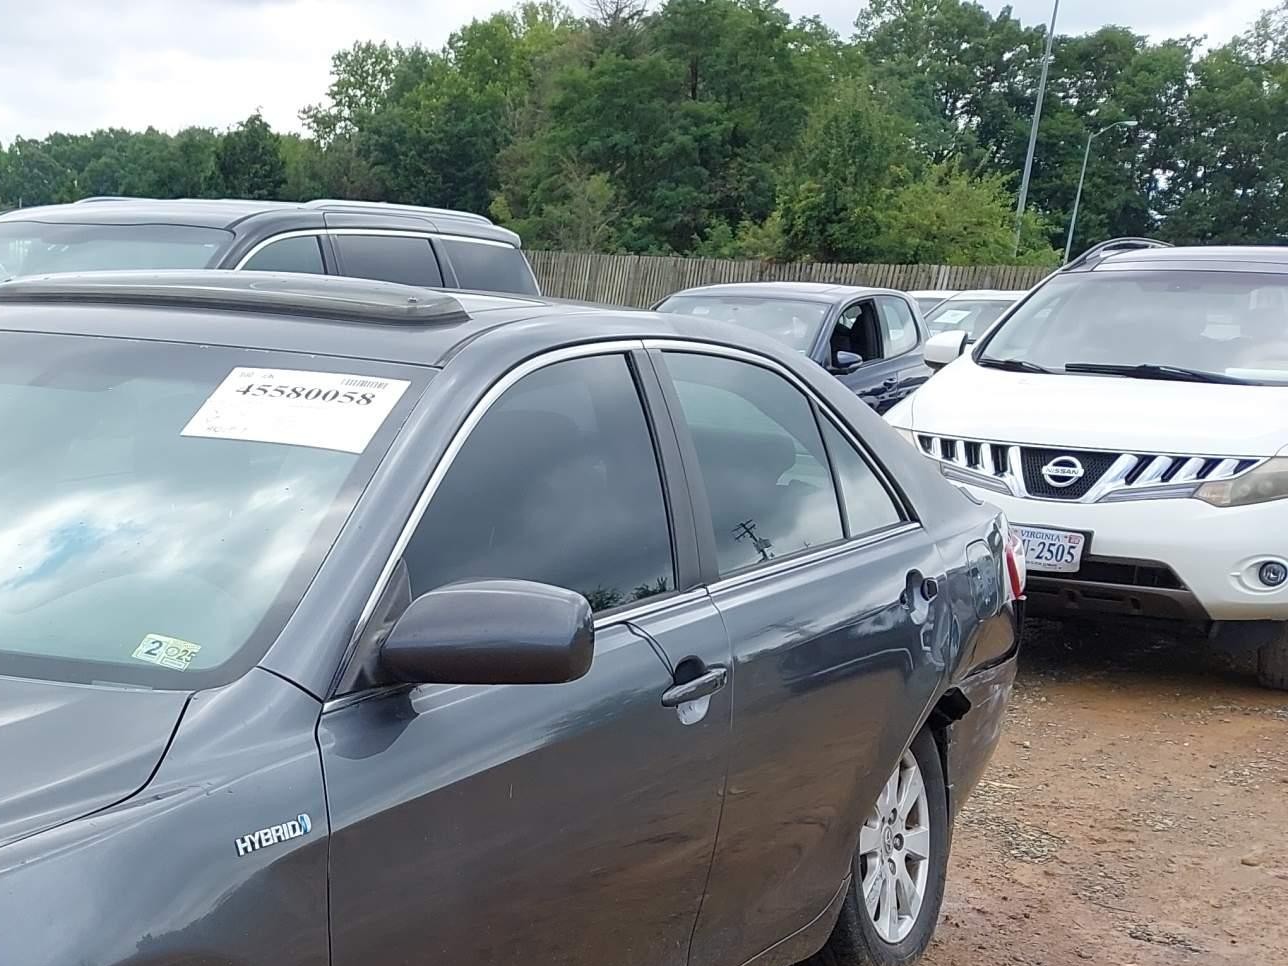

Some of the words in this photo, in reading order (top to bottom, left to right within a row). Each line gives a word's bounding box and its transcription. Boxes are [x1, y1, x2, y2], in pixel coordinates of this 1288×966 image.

[235, 383, 376, 406] 45580058
[1045, 467, 1080, 475] NISSAN
[1020, 530, 1061, 542] VIRGINIA
[145, 640, 163, 656] 2
[235, 820, 304, 856] HYBRID
